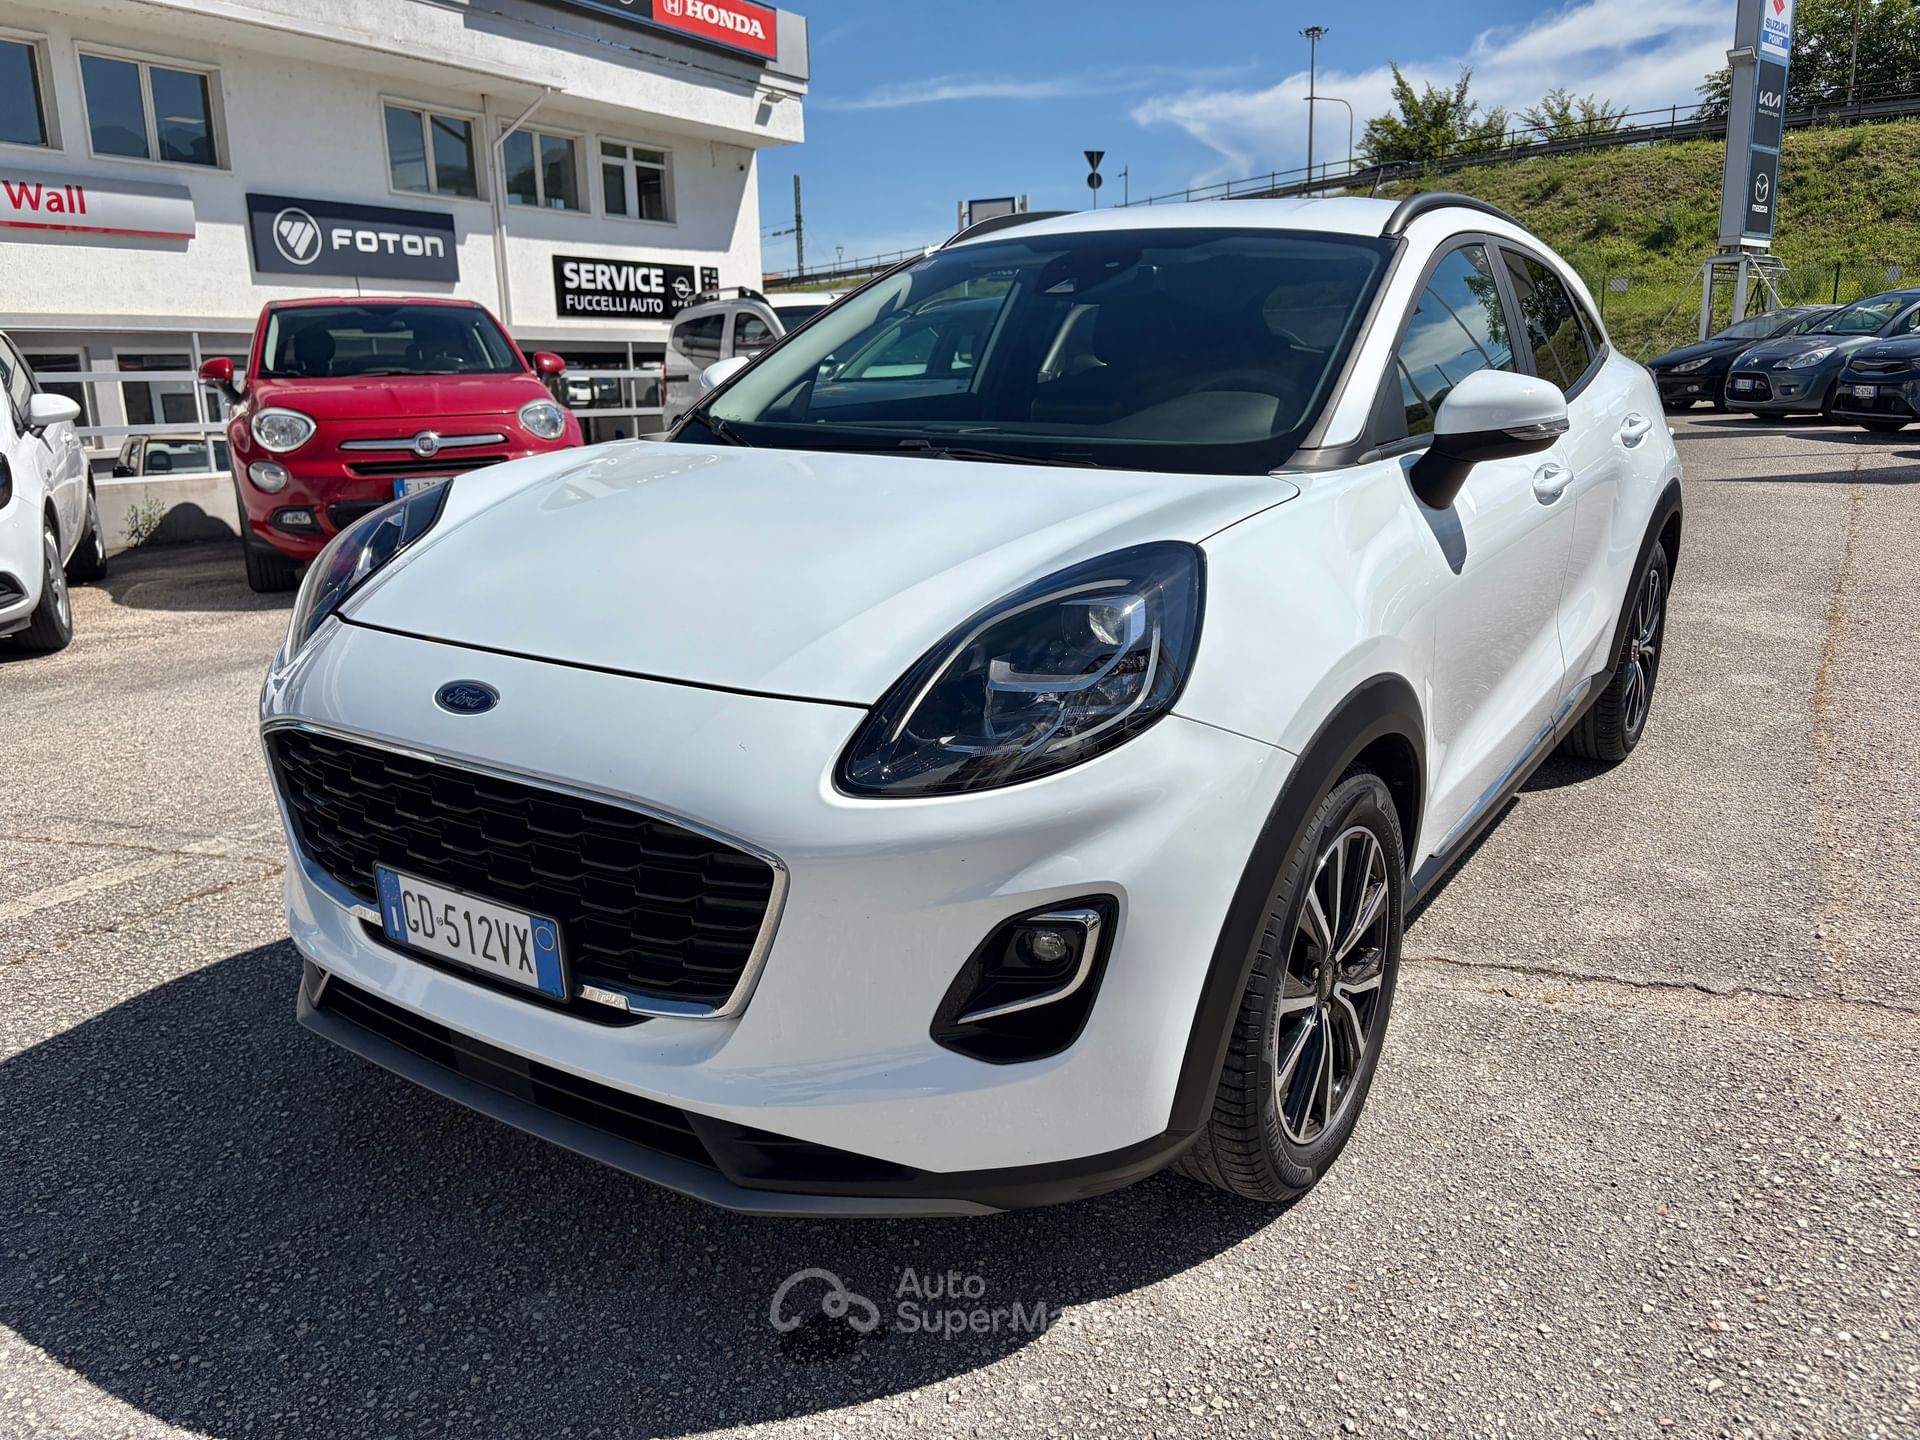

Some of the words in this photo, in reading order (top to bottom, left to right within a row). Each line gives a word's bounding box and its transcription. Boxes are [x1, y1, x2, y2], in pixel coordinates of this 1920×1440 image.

[685, 0, 766, 40] HONDA
[1765, 17, 1789, 35] SUZUKI
[1768, 33, 1784, 45] POINT
[2, 179, 87, 215] Wall
[331, 228, 445, 258] FOTON
[563, 262, 666, 294] SERVICE
[566, 294, 627, 312] FUCCELLI
[629, 297, 664, 313] AUTO
[446, 687, 486, 708] Ford
